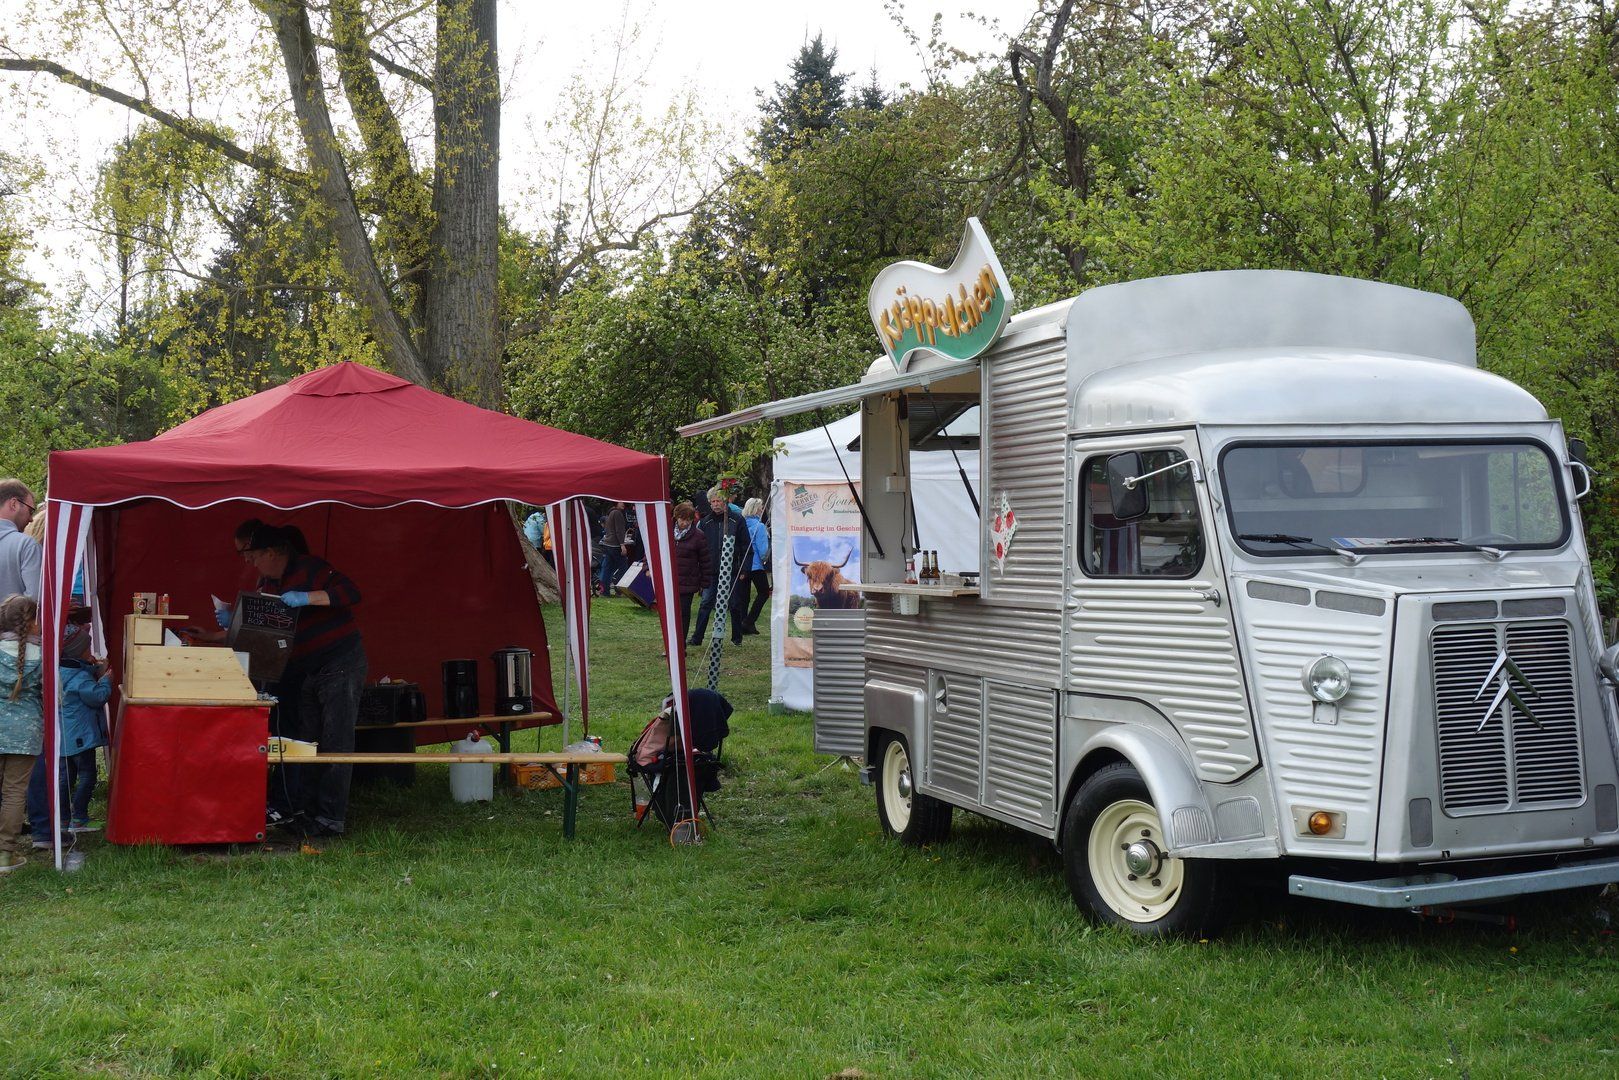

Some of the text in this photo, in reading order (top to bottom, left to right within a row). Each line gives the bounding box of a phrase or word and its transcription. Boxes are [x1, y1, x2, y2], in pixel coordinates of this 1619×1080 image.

[248, 605, 287, 615] OUTSIDE
[248, 610, 265, 619] THE
[248, 617, 264, 625] BOX
